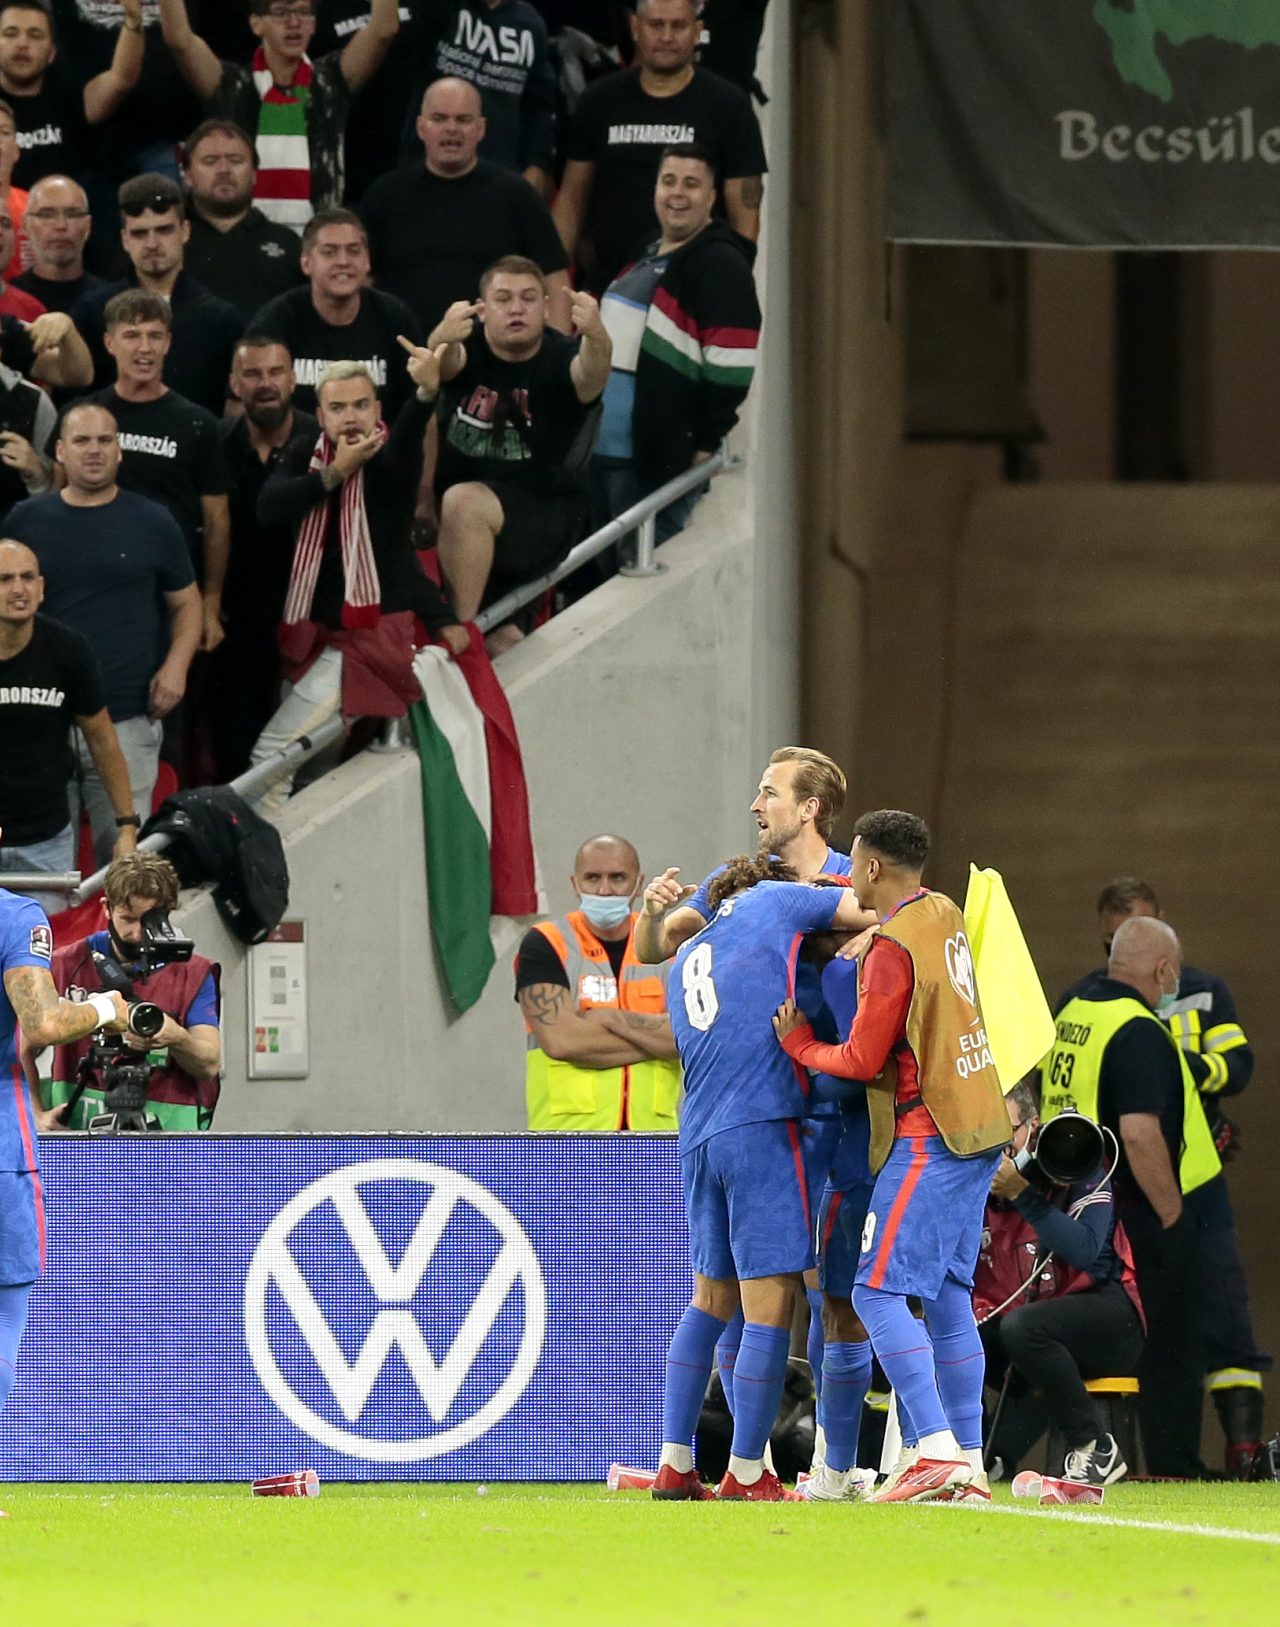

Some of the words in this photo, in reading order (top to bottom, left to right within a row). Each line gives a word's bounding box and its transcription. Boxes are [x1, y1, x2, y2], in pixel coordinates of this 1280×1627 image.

[455, 9, 534, 67] NASA
[1055, 107, 1280, 163] Becsüle
[116, 432, 178, 458] ARORSZÁG
[682, 942, 719, 1032] 8
[956, 1048, 995, 1079] QUA
